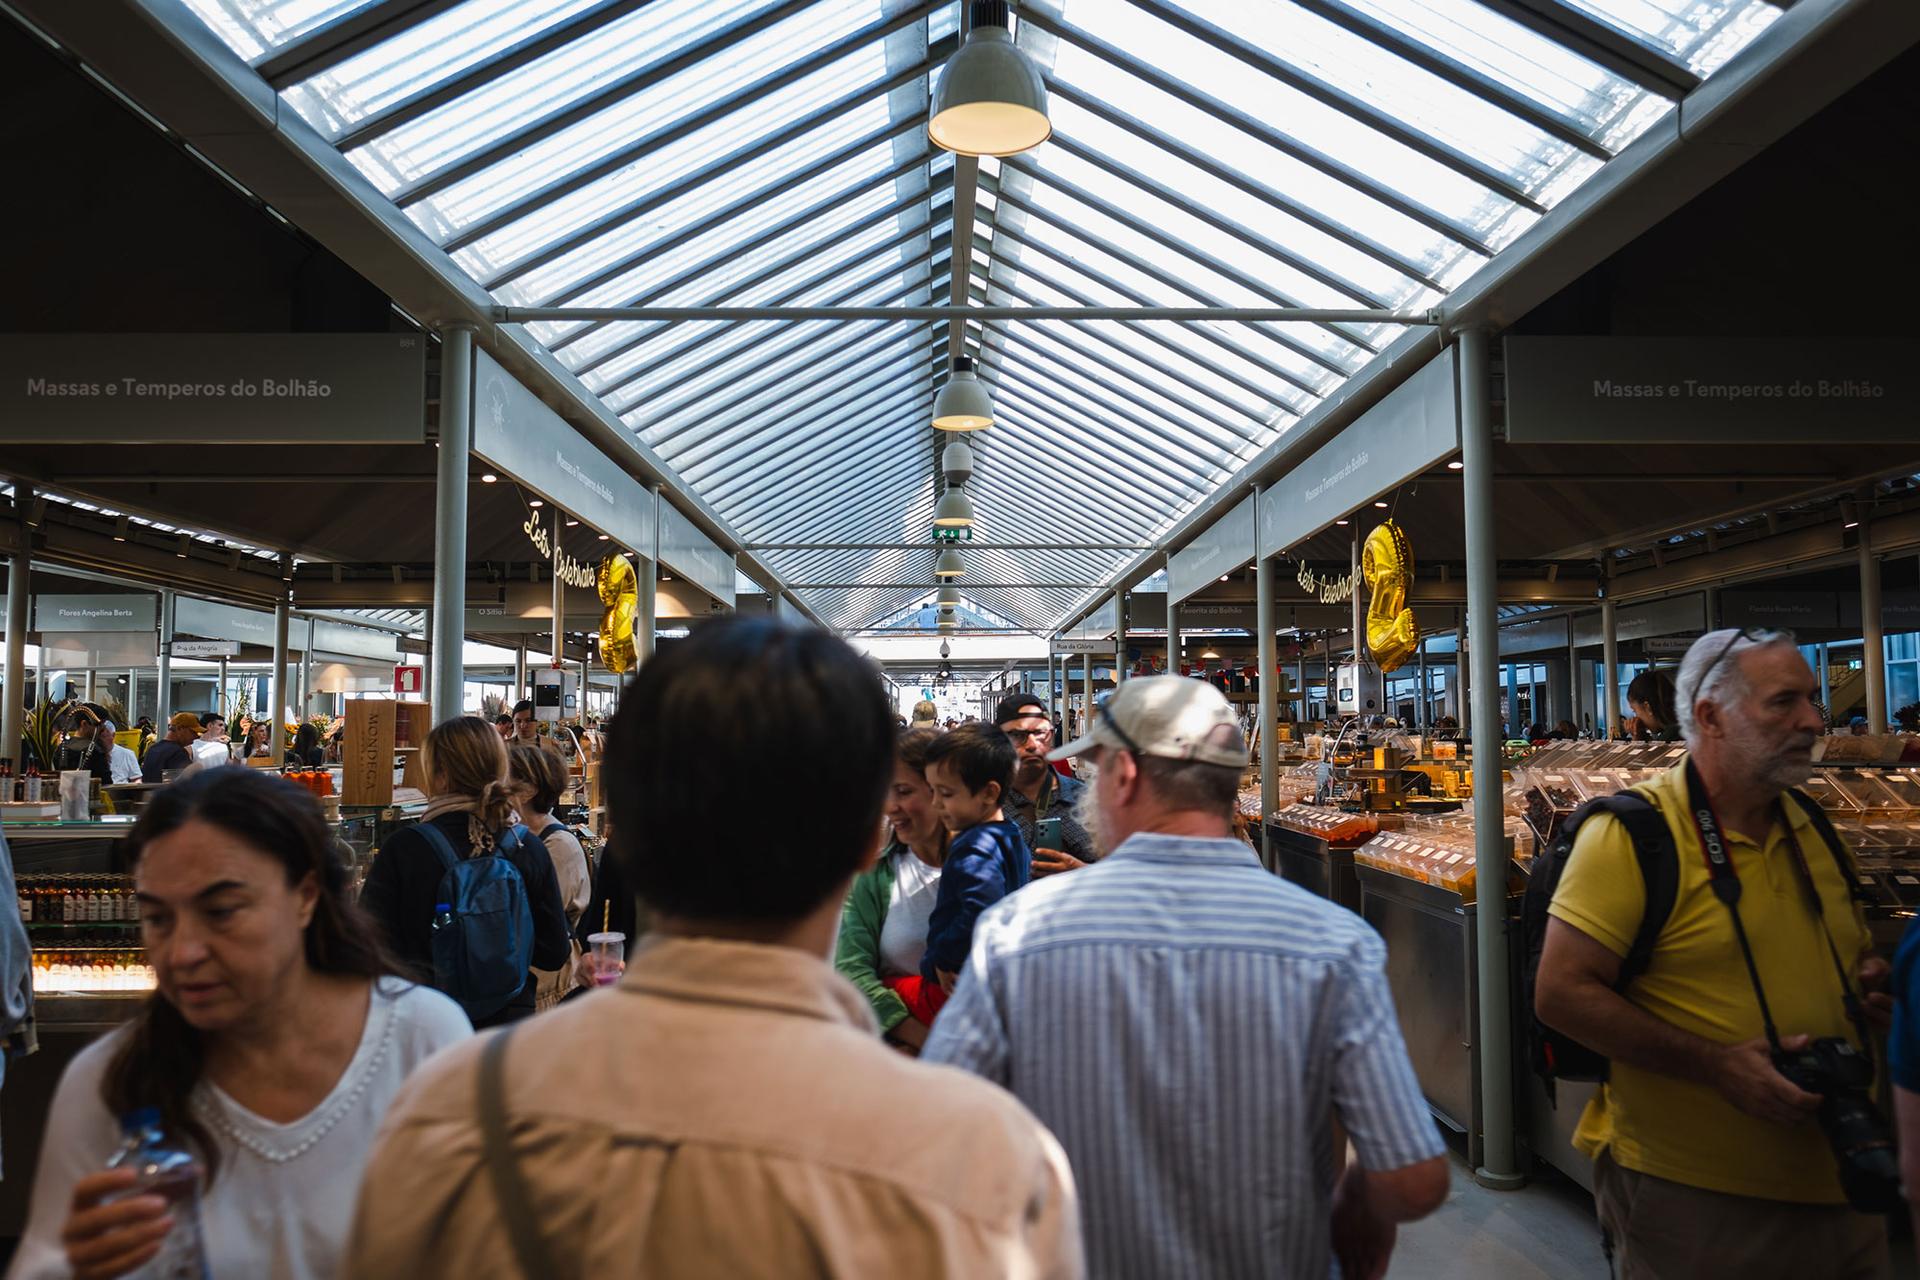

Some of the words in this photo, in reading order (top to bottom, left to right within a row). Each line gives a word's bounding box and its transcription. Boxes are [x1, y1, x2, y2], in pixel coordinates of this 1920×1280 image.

[26, 378, 100, 397] Massas
[105, 383, 118, 397] e
[122, 378, 226, 400] Temperos
[230, 378, 257, 397] do
[262, 378, 332, 397] Bolhão
[1592, 380, 1664, 397] Massas
[1668, 384, 1680, 397] e
[1683, 380, 1783, 400] Temperos
[1787, 380, 1813, 397] do
[1818, 380, 1884, 398] Bolhão
[554, 546, 596, 588] Celebrate
[58, 609, 81, 617] Flores
[81, 609, 113, 618] Angelina
[113, 609, 133, 617] Berta
[1704, 832, 1726, 864] EOS
